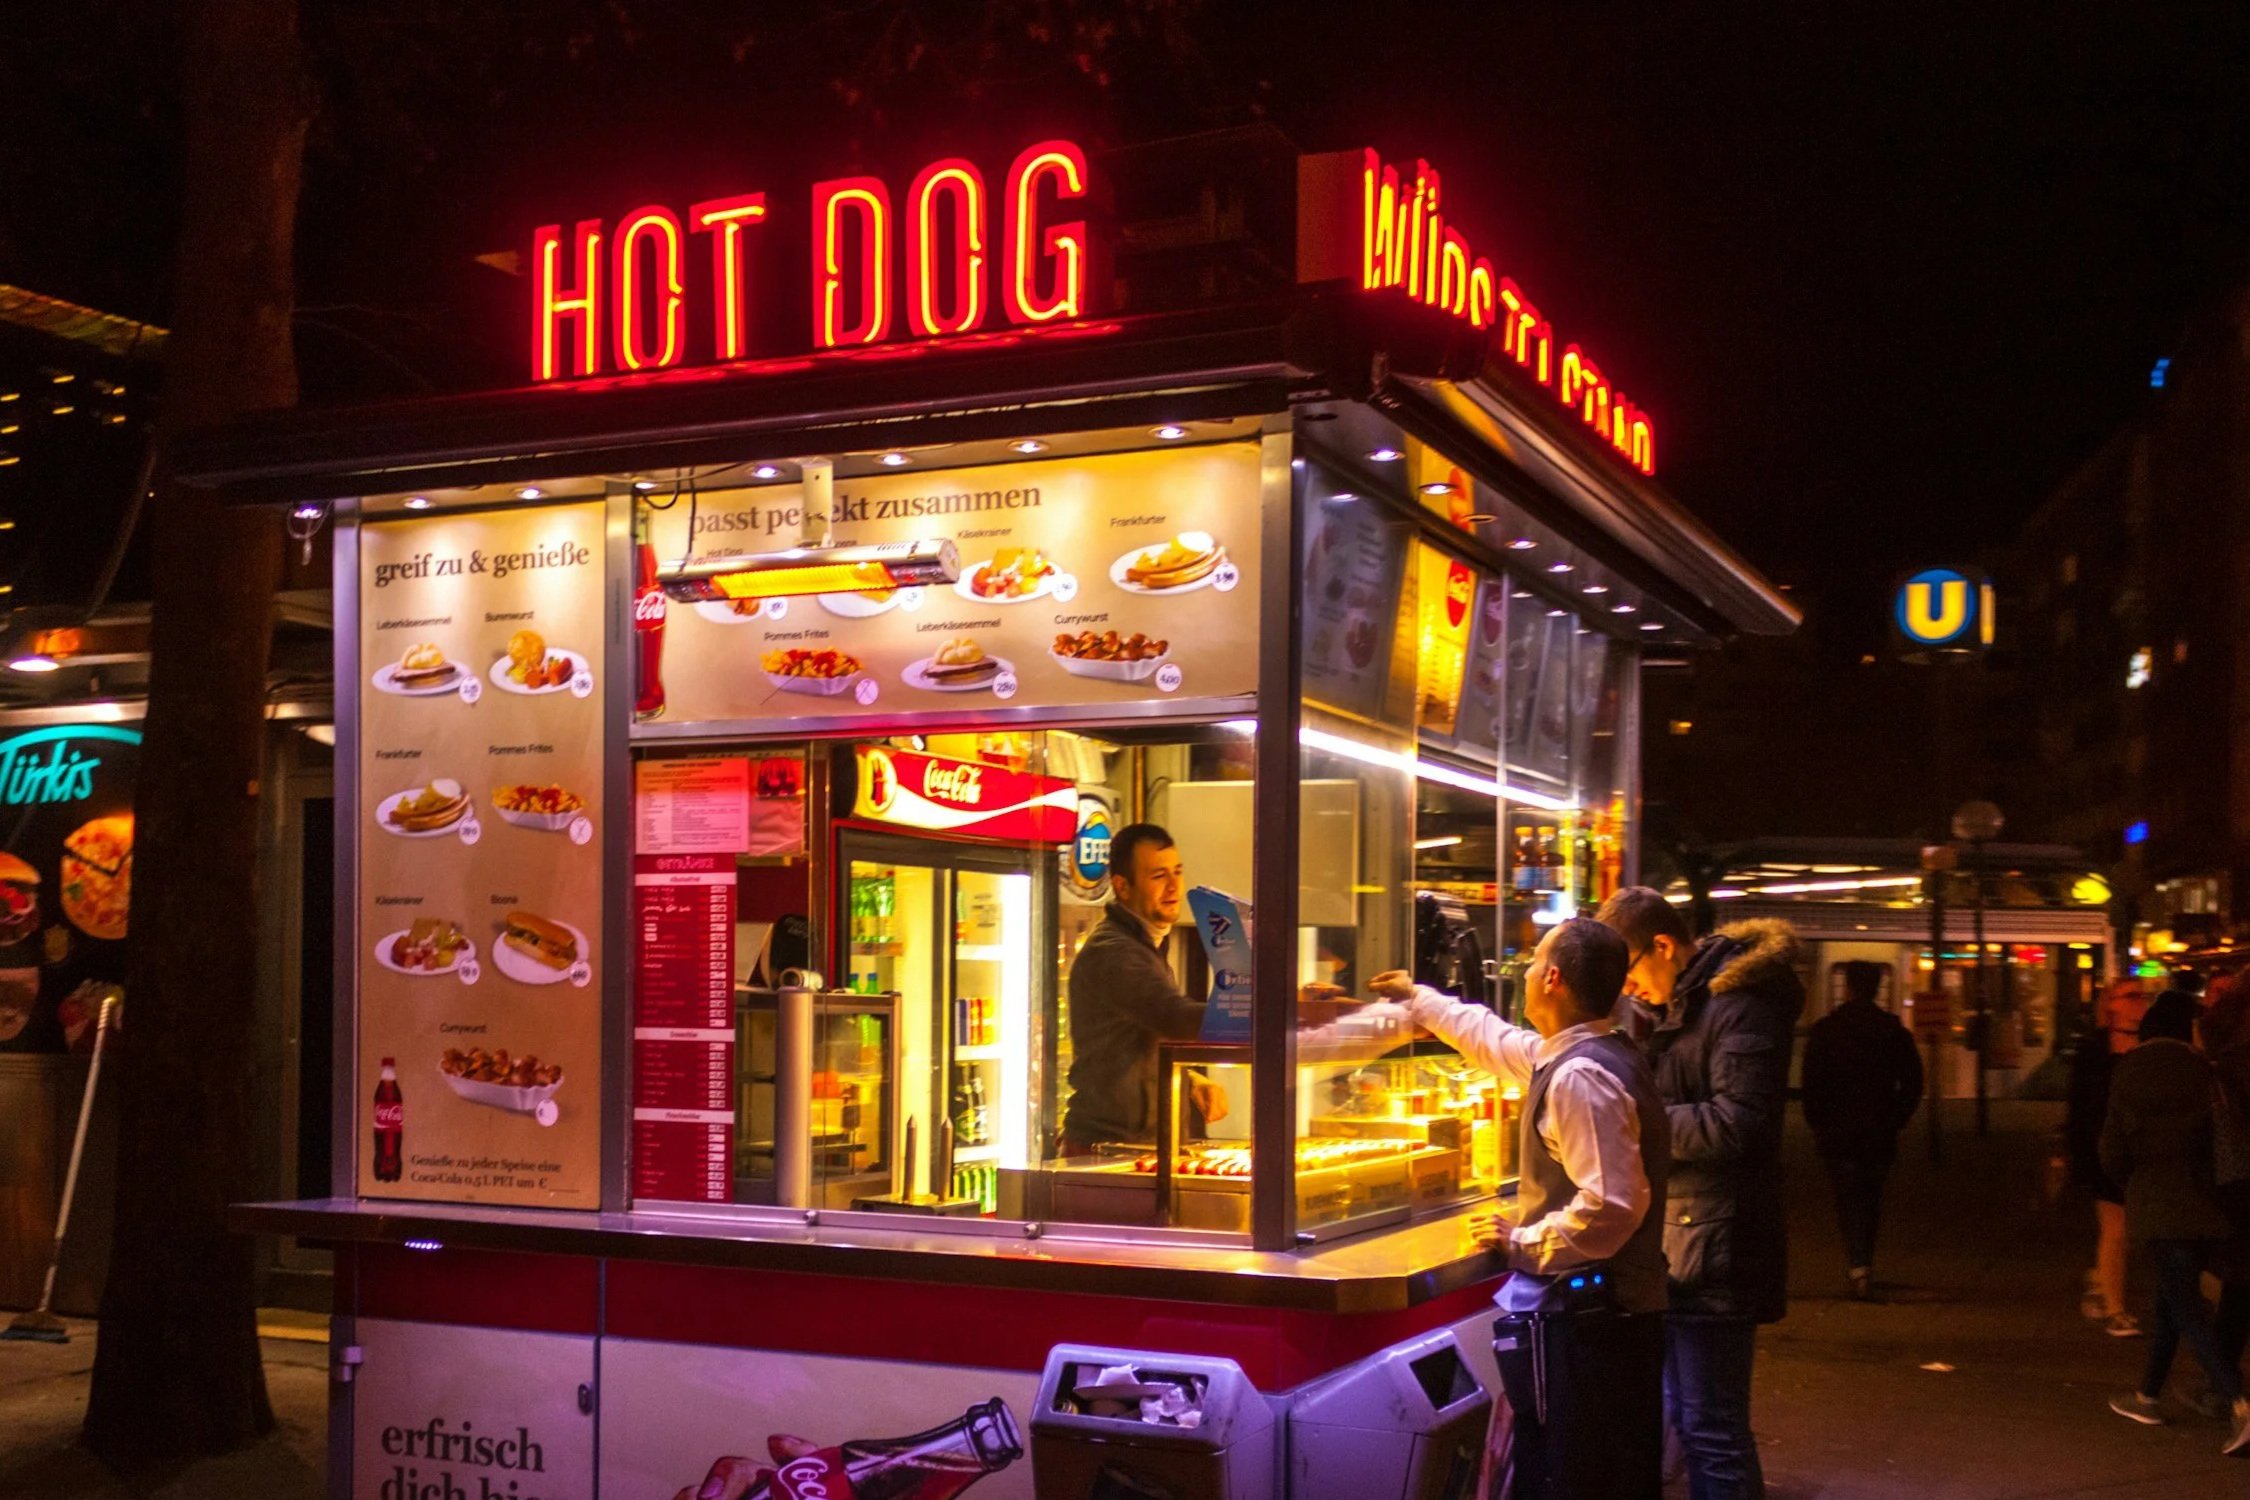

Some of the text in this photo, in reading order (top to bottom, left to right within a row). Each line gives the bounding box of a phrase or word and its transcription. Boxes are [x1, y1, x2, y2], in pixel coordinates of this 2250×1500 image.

[531, 140, 1088, 380] HOT DOG
[765, 494, 869, 536] peekt
[876, 487, 1042, 519] zusammen
[1110, 514, 1166, 528] Frankfurter
[374, 541, 590, 588] greif zu & genieße
[1053, 612, 1109, 628] Currywurst
[1905, 579, 1968, 641] U
[763, 628, 831, 642] Pommes Frites
[0, 728, 122, 805] Türkis
[411, 1154, 455, 1167] Genieße
[469, 1157, 500, 1171] jeder
[502, 1158, 537, 1172] Speise
[492, 1175, 515, 1188] PET
[516, 1179, 535, 1189] um
[381, 1417, 546, 1473] erfrisch
